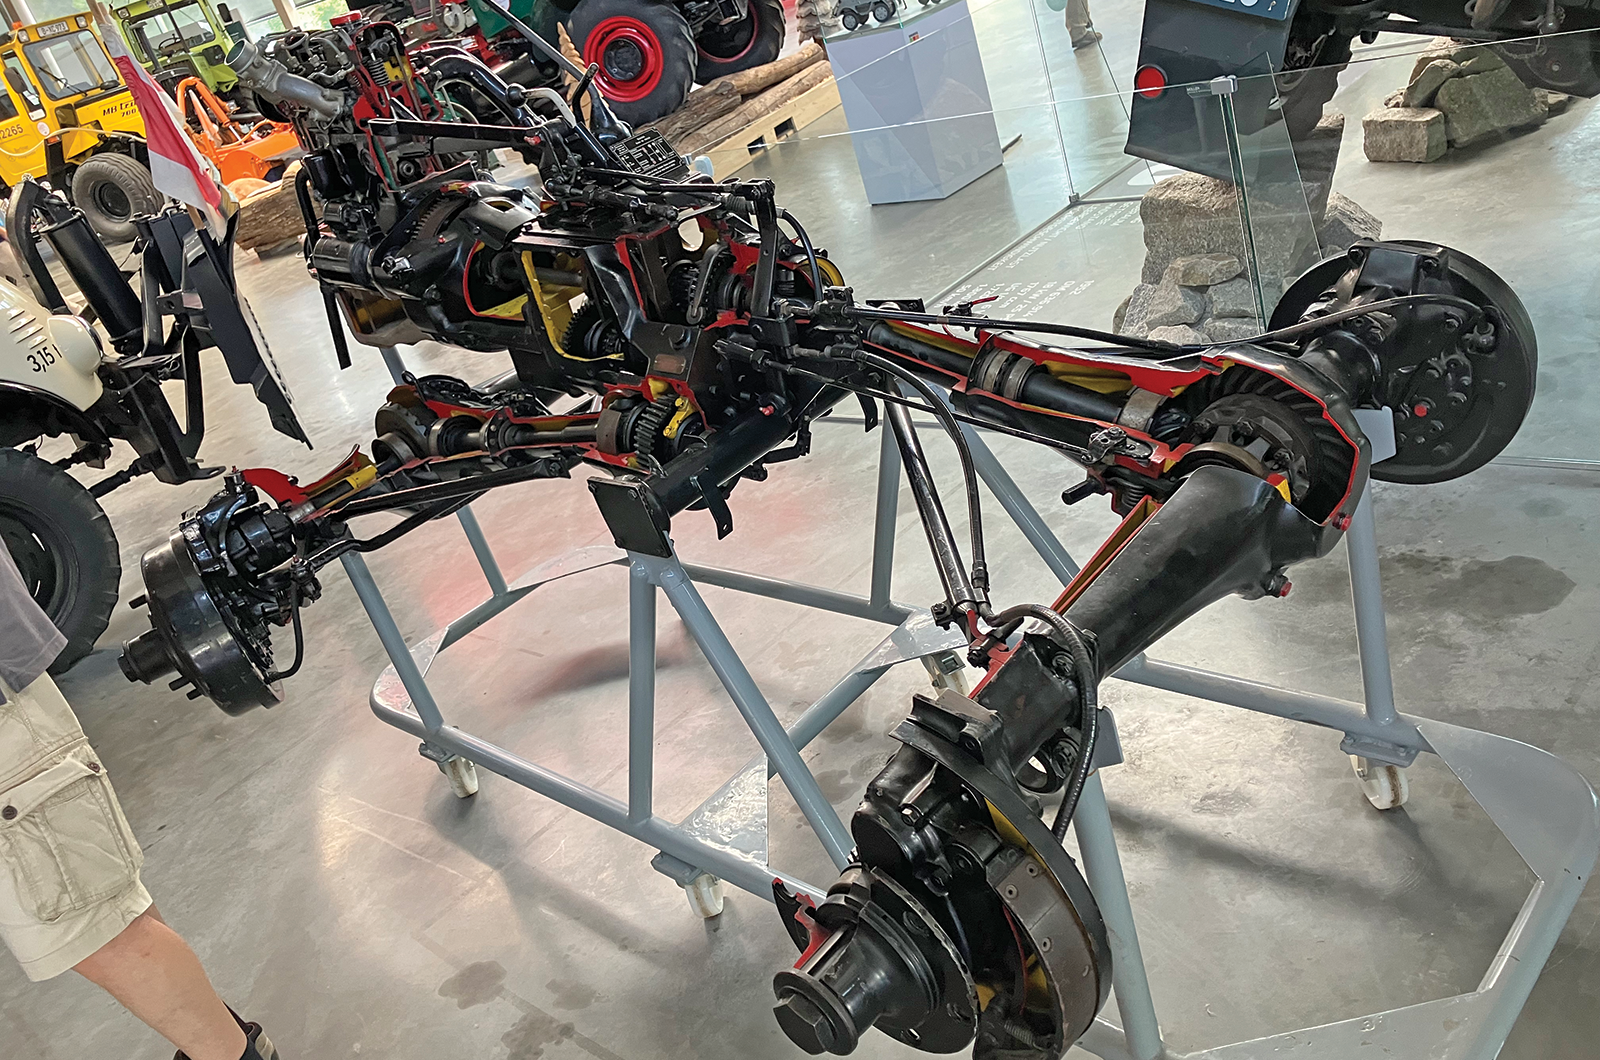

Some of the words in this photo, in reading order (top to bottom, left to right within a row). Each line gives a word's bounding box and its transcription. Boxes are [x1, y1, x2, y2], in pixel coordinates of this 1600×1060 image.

[102, 105, 118, 116] MB
[0, 123, 24, 140] 2265
[1016, 281, 1040, 296] 1767
[1068, 280, 1095, 295] 1952
[26, 346, 55, 373] 3,15
